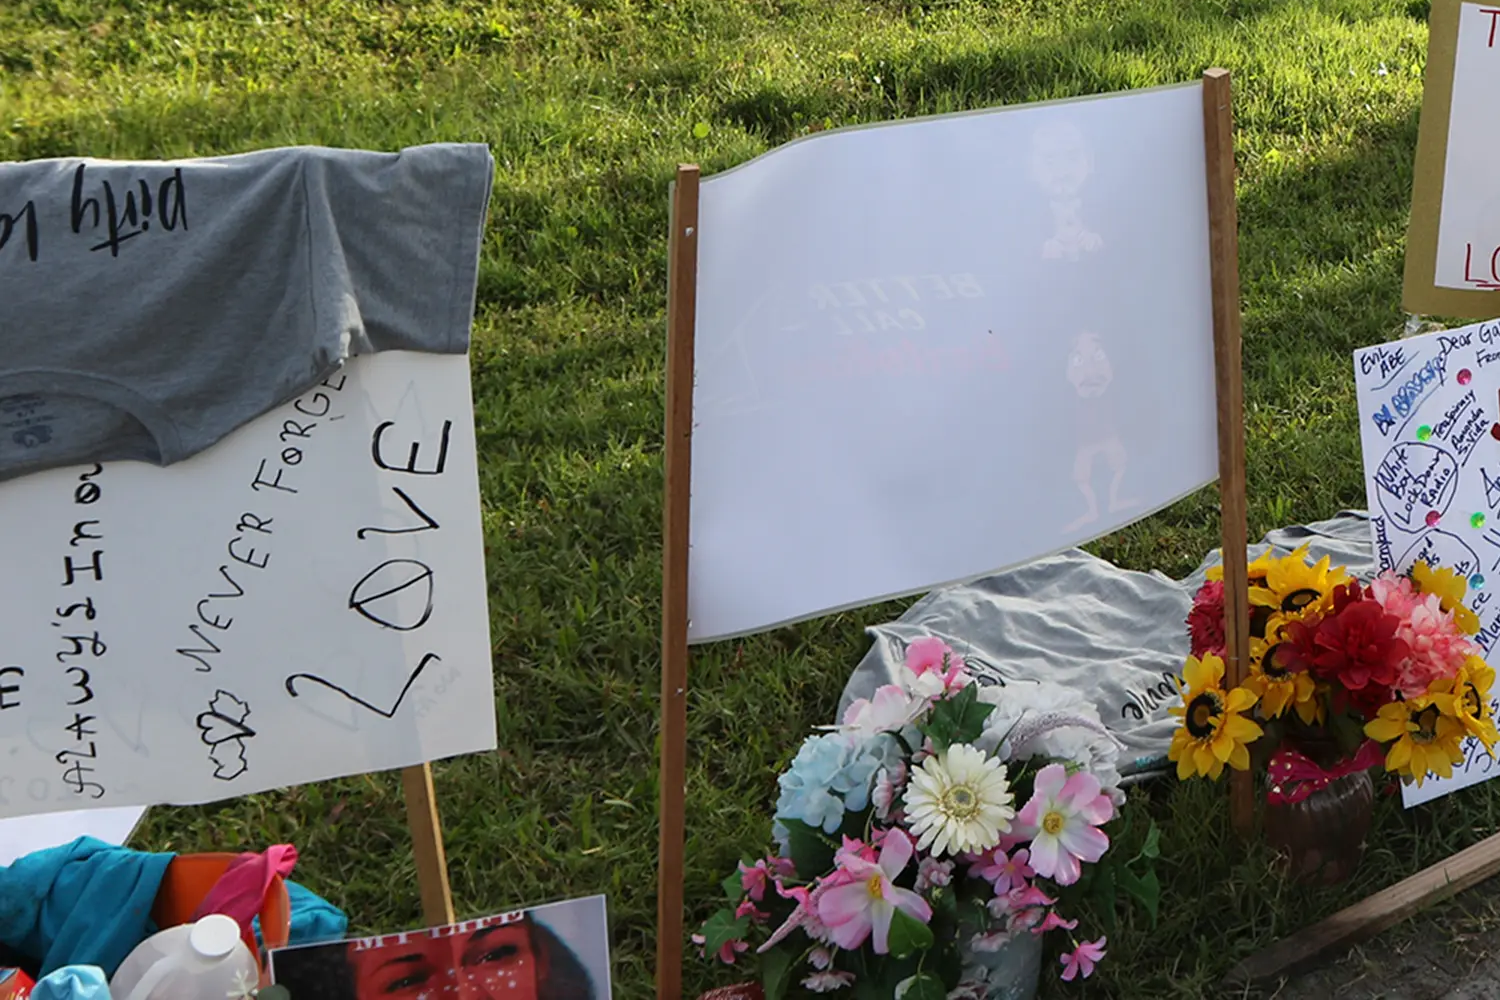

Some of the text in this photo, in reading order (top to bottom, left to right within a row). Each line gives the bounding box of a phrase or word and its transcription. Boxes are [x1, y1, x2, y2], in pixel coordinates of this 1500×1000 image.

[1380, 347, 1406, 379] ABE
[1436, 332, 1474, 355] Dear
[175, 374, 347, 673] NEVER FORGE
[284, 419, 452, 719] LOVE
